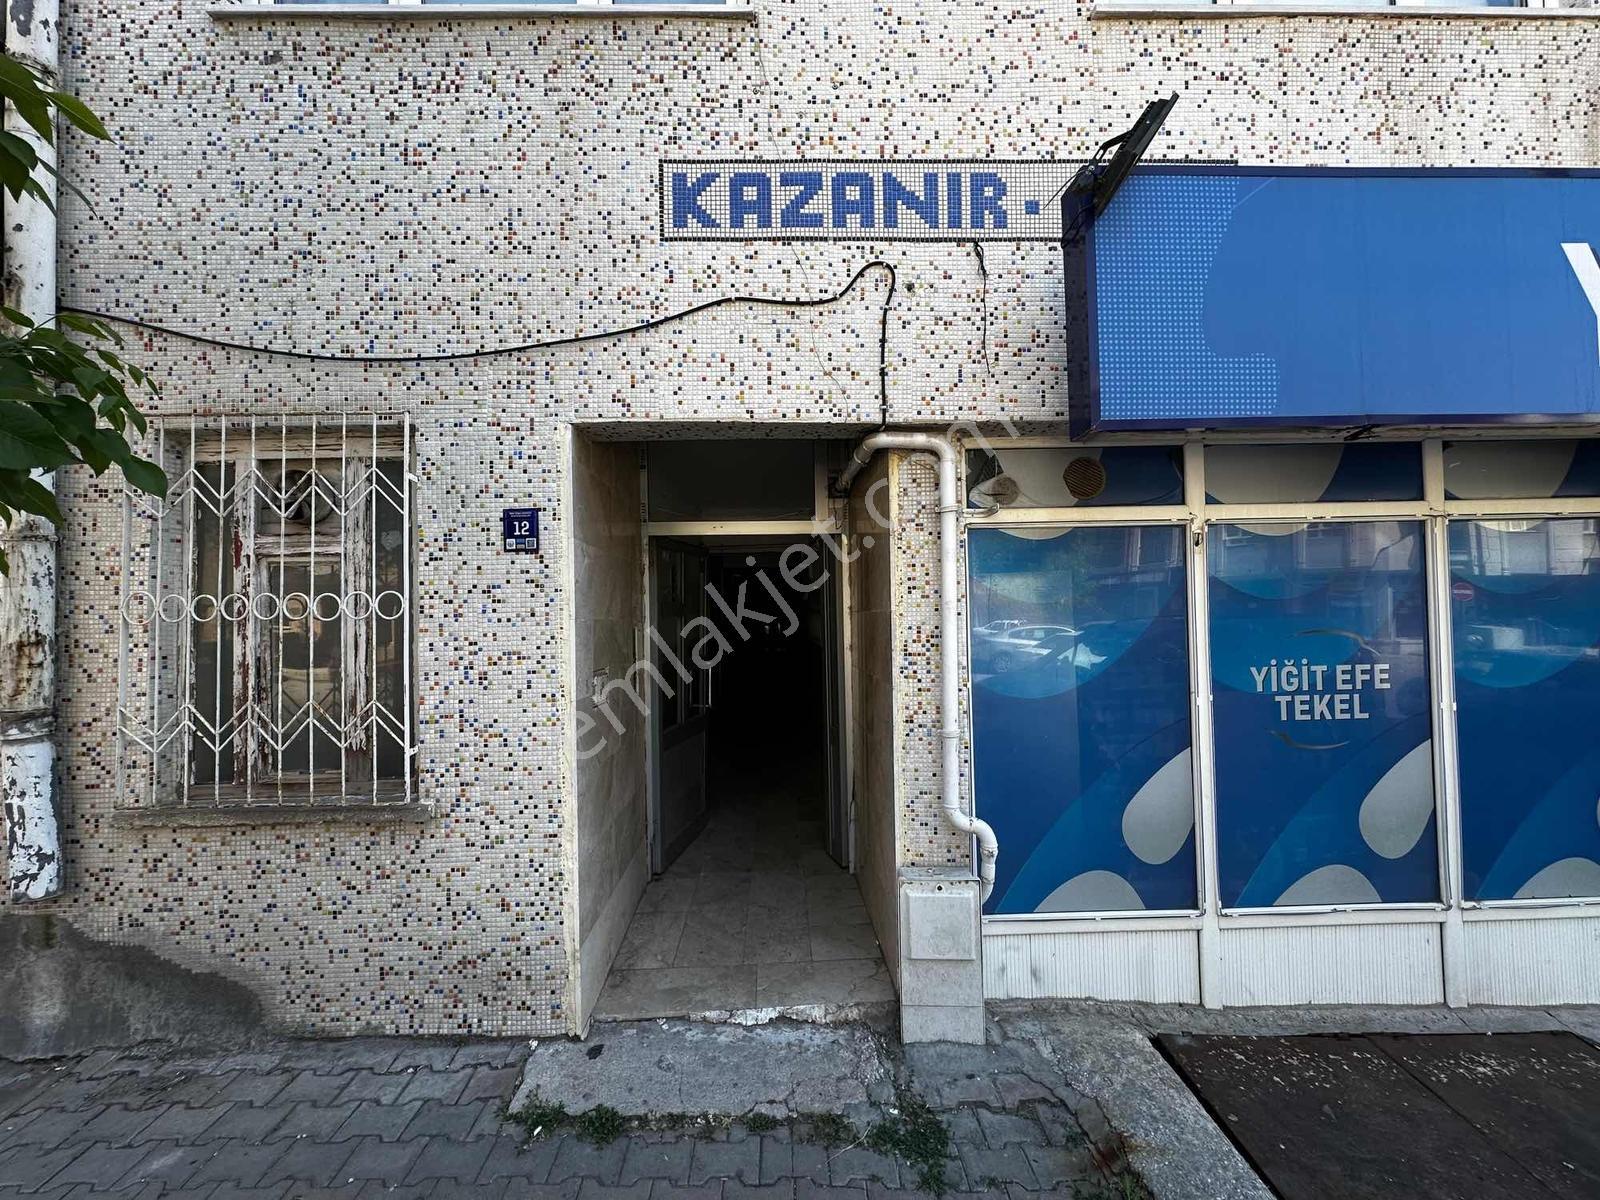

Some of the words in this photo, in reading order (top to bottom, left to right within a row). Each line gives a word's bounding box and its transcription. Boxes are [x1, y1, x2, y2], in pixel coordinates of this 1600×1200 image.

[513, 520, 530, 536] 12
[1250, 658, 1328, 692] YİĞİT
[1336, 663, 1391, 690] EFE
[1274, 693, 1370, 721] TEKEL
